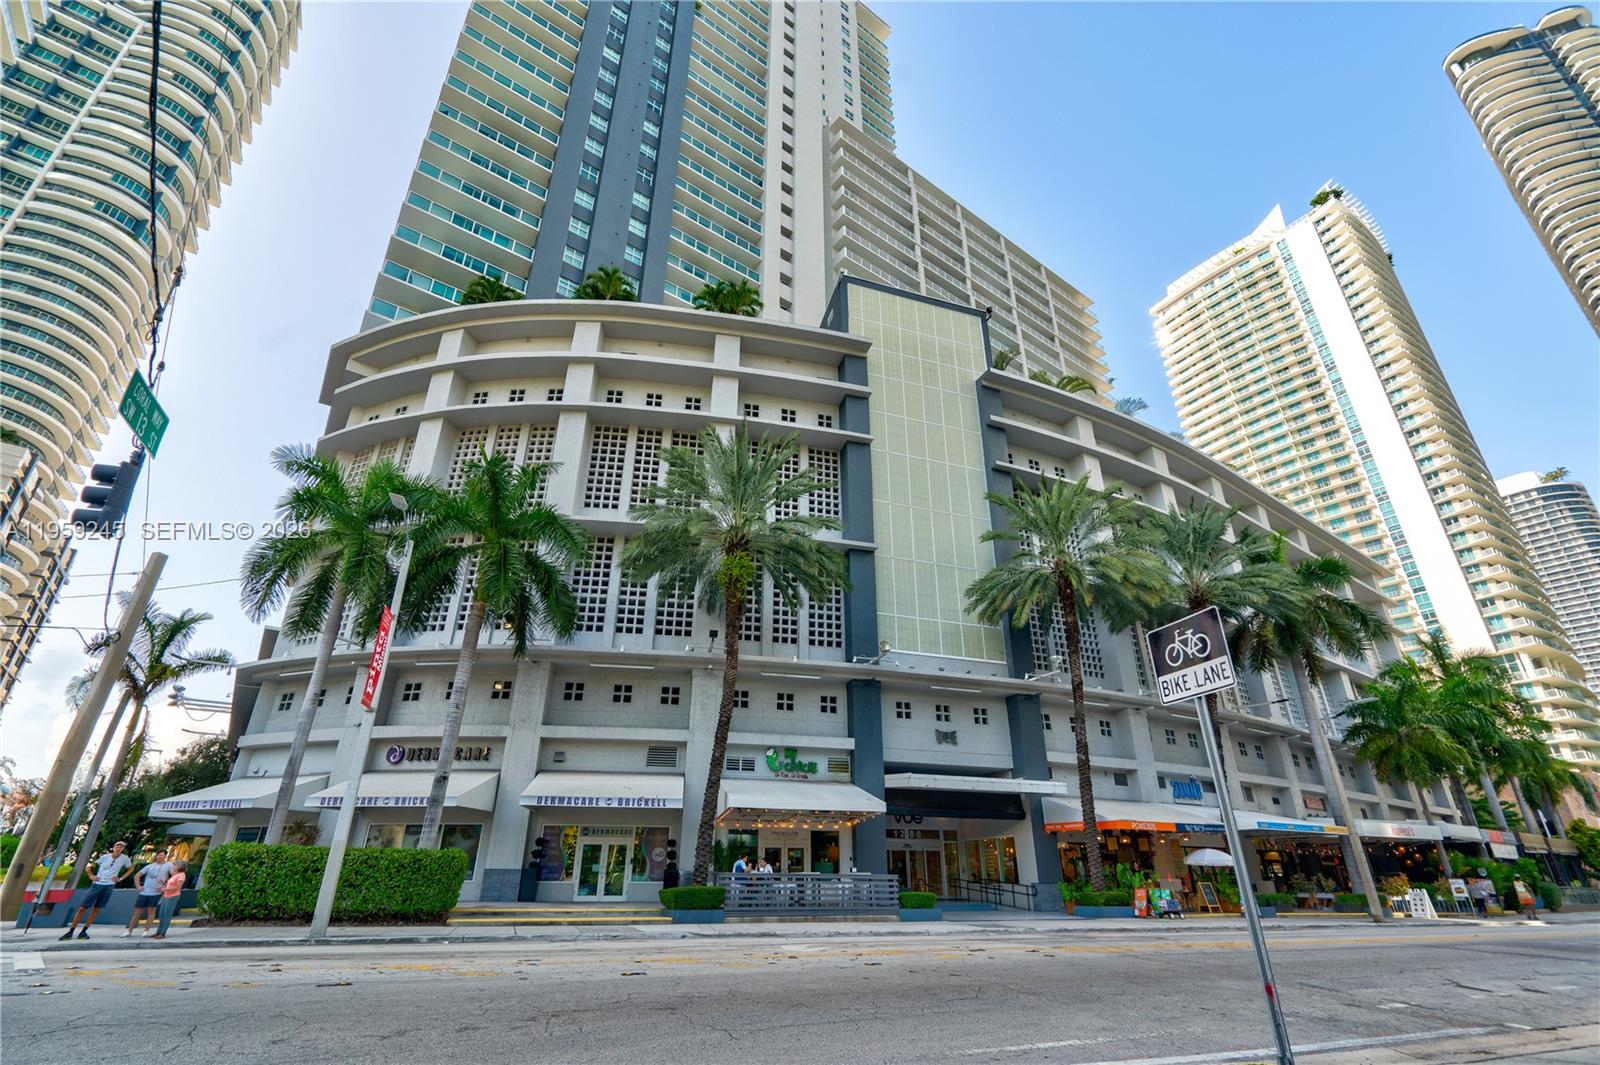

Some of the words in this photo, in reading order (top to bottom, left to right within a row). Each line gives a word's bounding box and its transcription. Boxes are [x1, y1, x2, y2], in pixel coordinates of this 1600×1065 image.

[133, 382, 152, 414] CORAL
[151, 408, 165, 431] WAY
[123, 398, 137, 421] SW
[135, 412, 148, 437] 13
[147, 431, 158, 452] ST
[1161, 673, 1192, 698] BIKE
[1194, 660, 1231, 688] LANE
[405, 747, 491, 762] DERMCARE
[161, 801, 200, 810] DERMACARE
[209, 799, 242, 809] BRICKELL
[320, 796, 379, 806] DERCARE
[536, 795, 601, 806] DERMACARE
[617, 797, 668, 808] BRICKELL
